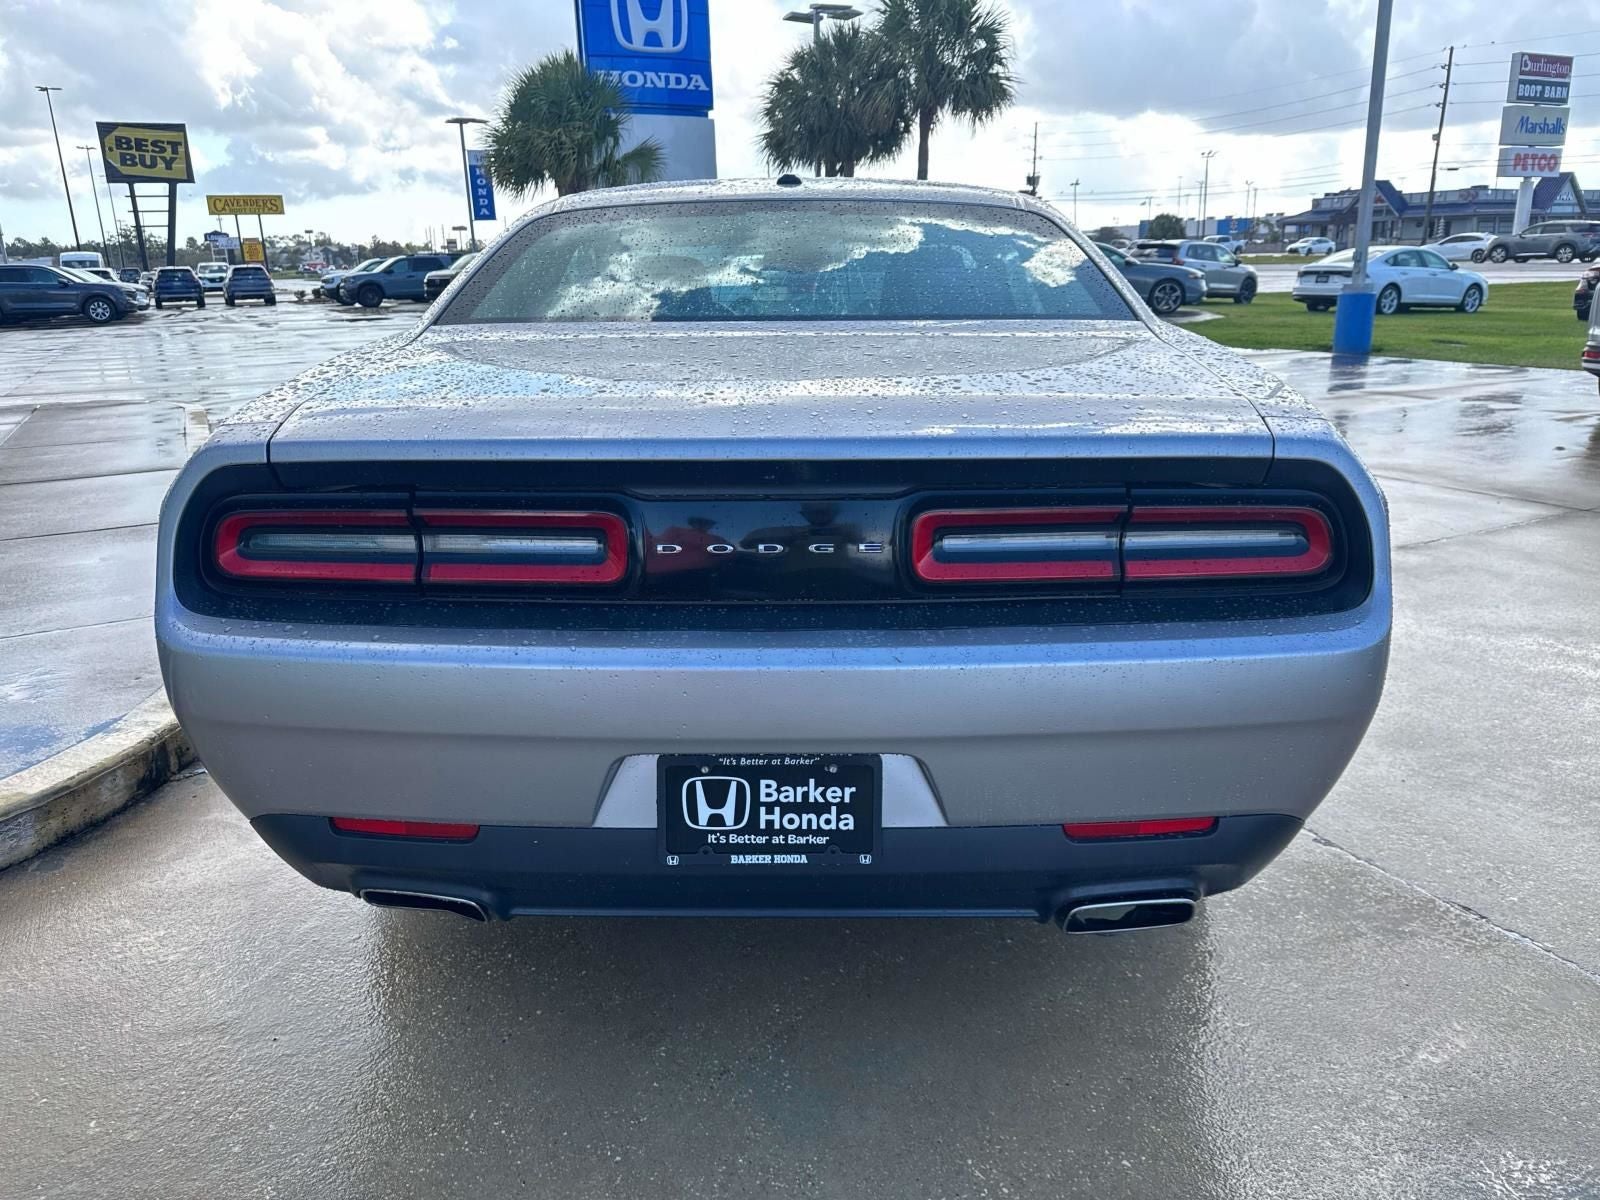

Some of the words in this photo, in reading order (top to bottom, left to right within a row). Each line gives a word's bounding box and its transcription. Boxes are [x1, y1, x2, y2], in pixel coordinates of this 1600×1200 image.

[1521, 54, 1570, 77] Burlington
[1518, 84, 1542, 97] BOOT
[1544, 85, 1569, 98] BARN
[1515, 115, 1565, 135] Marshalls
[114, 135, 182, 155] BEST
[119, 152, 178, 171] BUY
[1512, 152, 1559, 172] PETCO
[475, 167, 490, 215] HONDA
[656, 543, 882, 554] DODGE
[740, 757, 768, 766] Better
[771, 758, 781, 766] at
[759, 778, 856, 804] Barker
[759, 806, 855, 831] Honda
[707, 832, 727, 844] It's
[729, 833, 769, 844] Better
[771, 834, 785, 844] at
[788, 834, 830, 845] Barker
[730, 854, 772, 864] BARKER
[773, 854, 808, 864] HONDA
